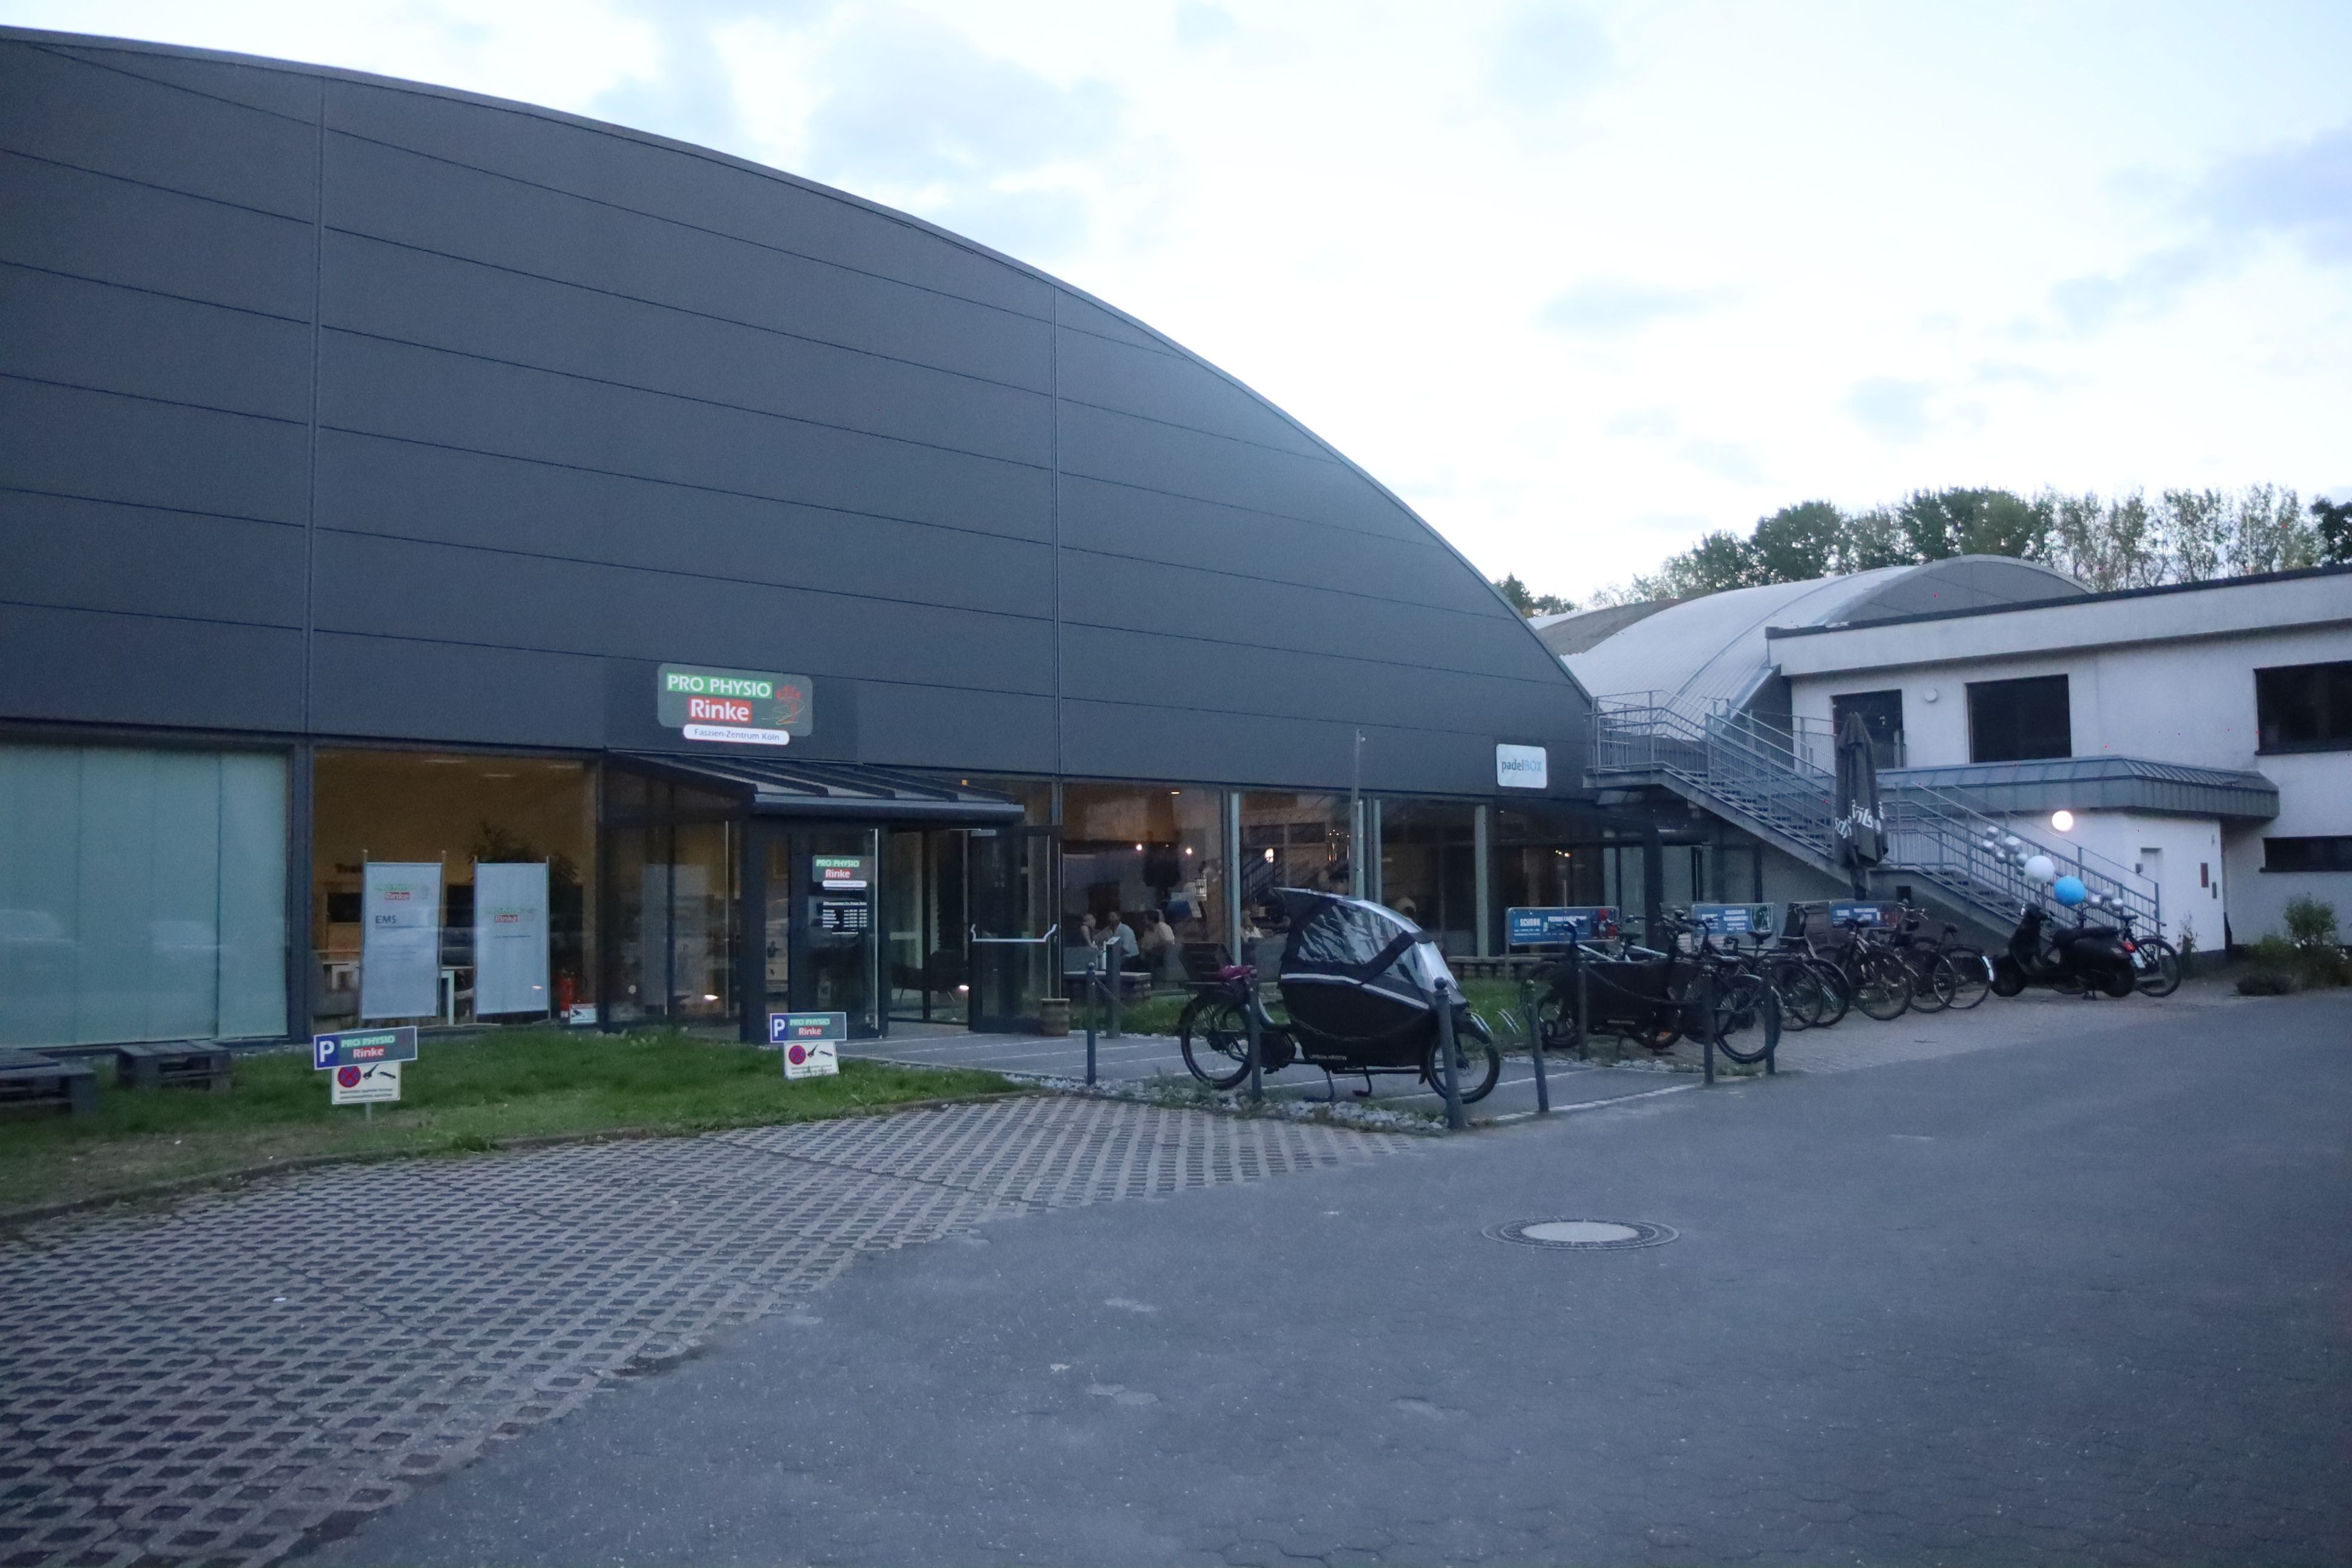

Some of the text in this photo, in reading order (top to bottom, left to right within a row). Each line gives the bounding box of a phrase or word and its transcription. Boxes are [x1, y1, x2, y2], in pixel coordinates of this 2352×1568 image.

[667, 675, 771, 697] PRO PHYSIO
[690, 699, 750, 721] Rinke
[694, 728, 759, 739] Faszien-Zentrum
[1501, 759, 1543, 773] padelBOX
[833, 859, 860, 867] PHYSIO
[825, 869, 851, 878] Rinke
[375, 915, 397, 924] EMS
[798, 1027, 822, 1036] Rinke
[341, 1038, 361, 1048] PRO
[363, 1035, 395, 1046] PHYSIO
[353, 1048, 384, 1059] Rinke
